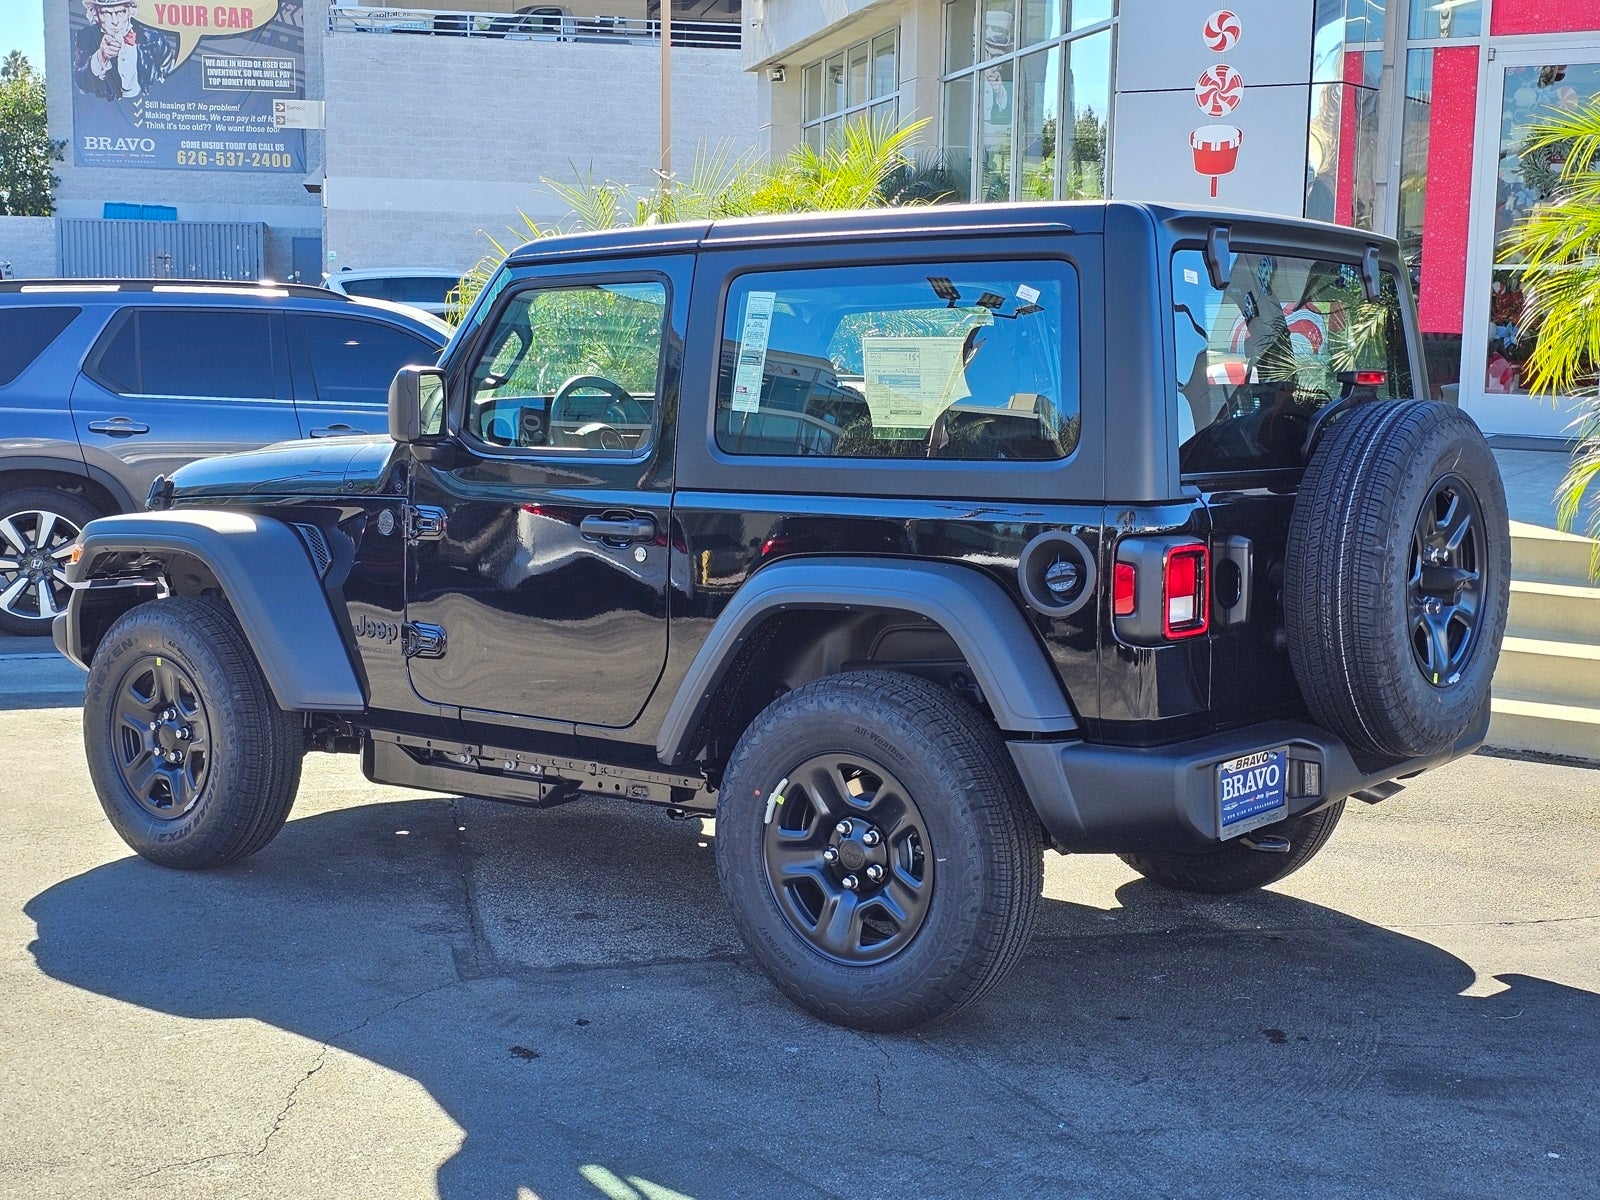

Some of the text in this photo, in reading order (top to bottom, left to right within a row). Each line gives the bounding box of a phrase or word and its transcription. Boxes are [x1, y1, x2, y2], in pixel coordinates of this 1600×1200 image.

[154, 4, 254, 28] YOUR CAR
[216, 59, 229, 67] ARE
[237, 60, 252, 68] NEED
[262, 61, 278, 69] USED
[208, 78, 221, 86] TOP
[222, 78, 243, 86] MONEY
[145, 111, 170, 120] Making
[172, 112, 208, 121] Payments,
[160, 102, 185, 111] leasing
[187, 102, 195, 110] it?
[209, 104, 240, 112] problem!
[166, 122, 177, 130] it's
[246, 125, 265, 133] those
[84, 136, 155, 152] BRAVO
[181, 140, 200, 149] COME
[202, 141, 224, 150] INSIDE
[225, 142, 246, 150] TODAY
[258, 143, 274, 151] CALL
[177, 150, 292, 168] 626-537-2400
[354, 615, 398, 644] Jeep
[168, 640, 197, 672] All-Weather
[92, 638, 134, 701] NEXEN
[854, 726, 906, 760] All-Weather
[1235, 751, 1270, 770] BRAVO
[1222, 764, 1280, 801] BRAVO
